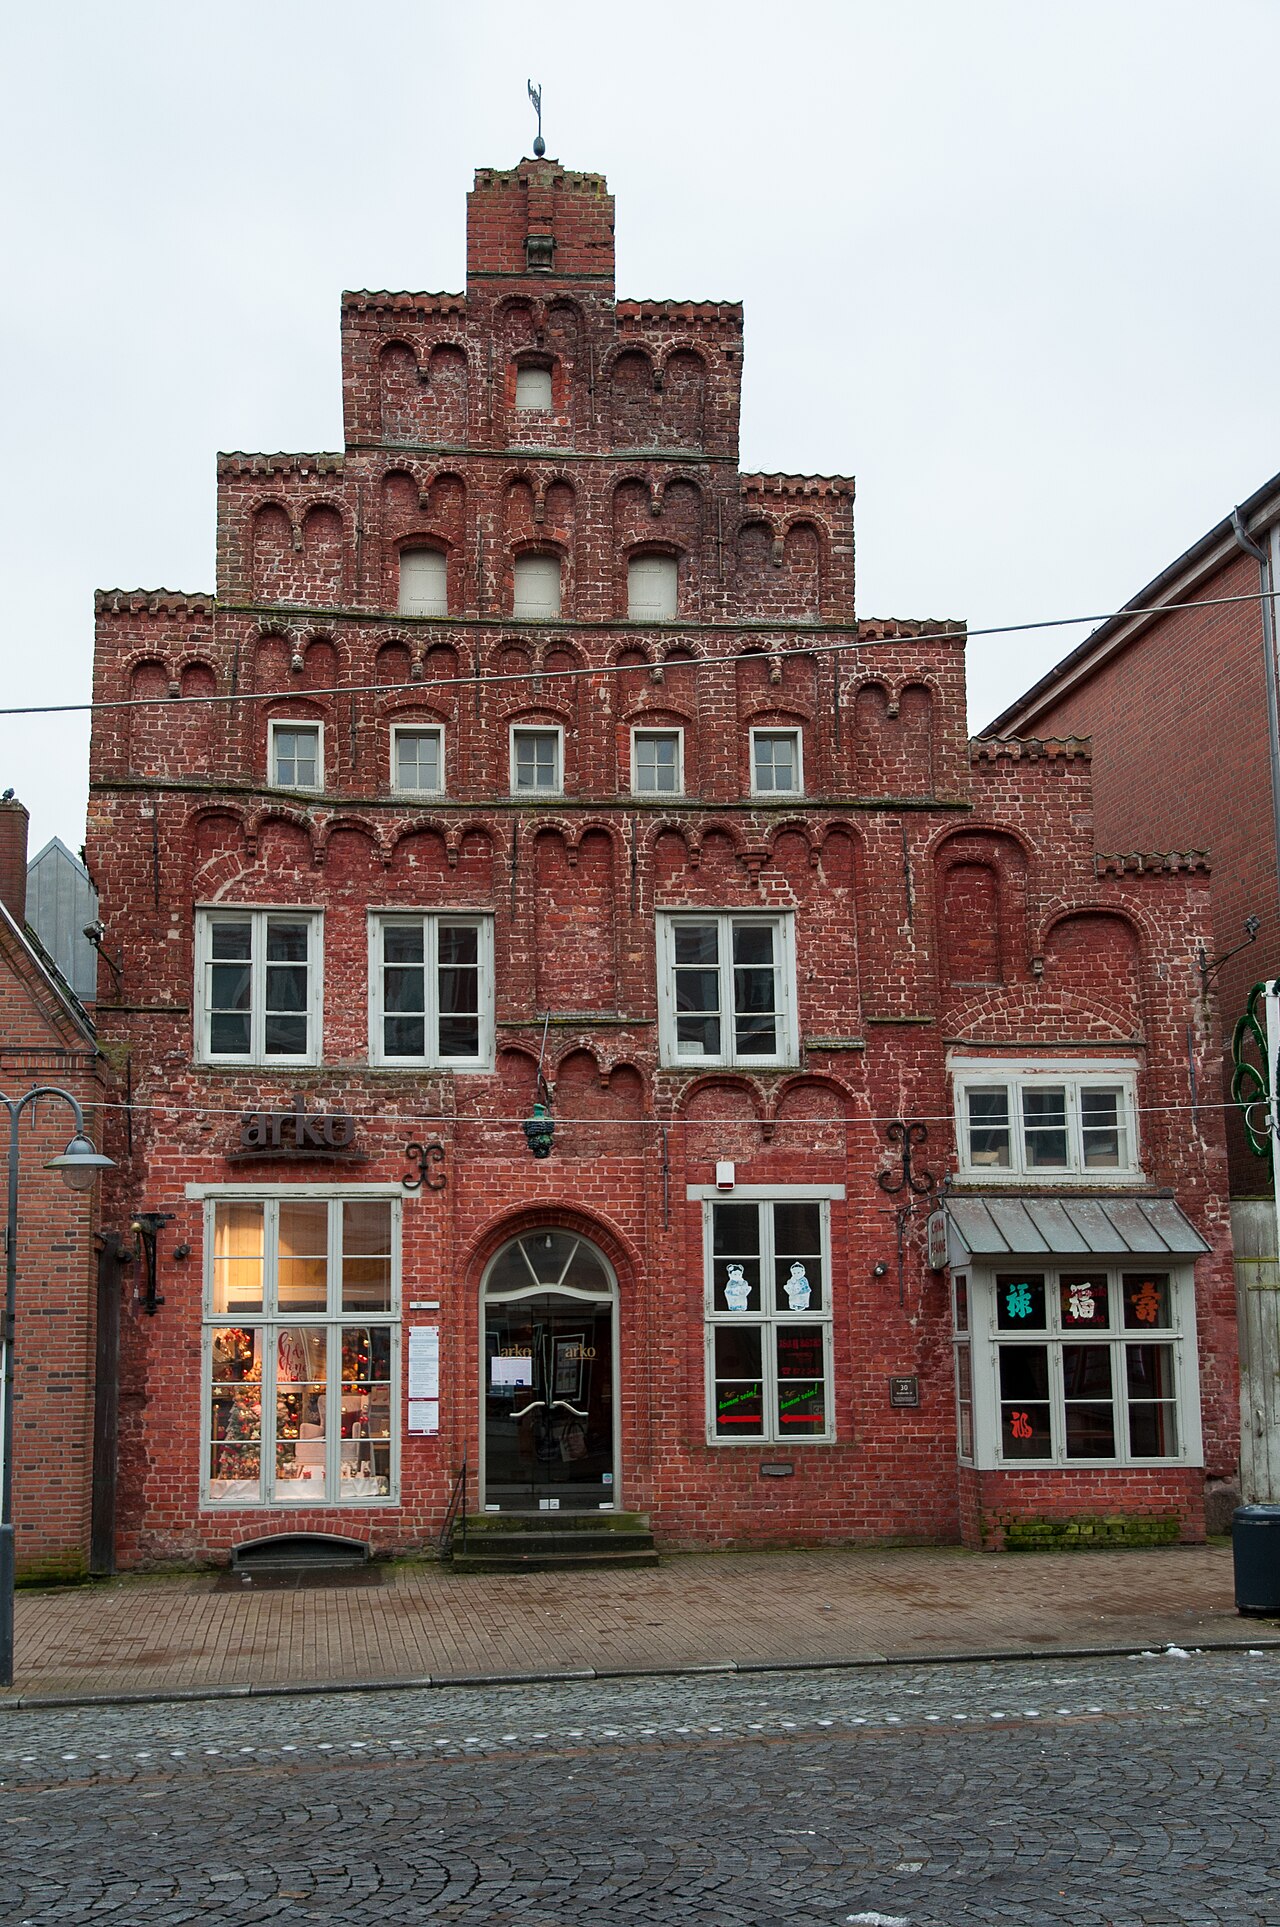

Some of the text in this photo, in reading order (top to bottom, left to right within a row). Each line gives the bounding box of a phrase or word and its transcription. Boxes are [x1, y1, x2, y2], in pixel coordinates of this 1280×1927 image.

[240, 1093, 355, 1146] arko
[501, 1343, 532, 1357] arko
[565, 1344, 596, 1358] arko
